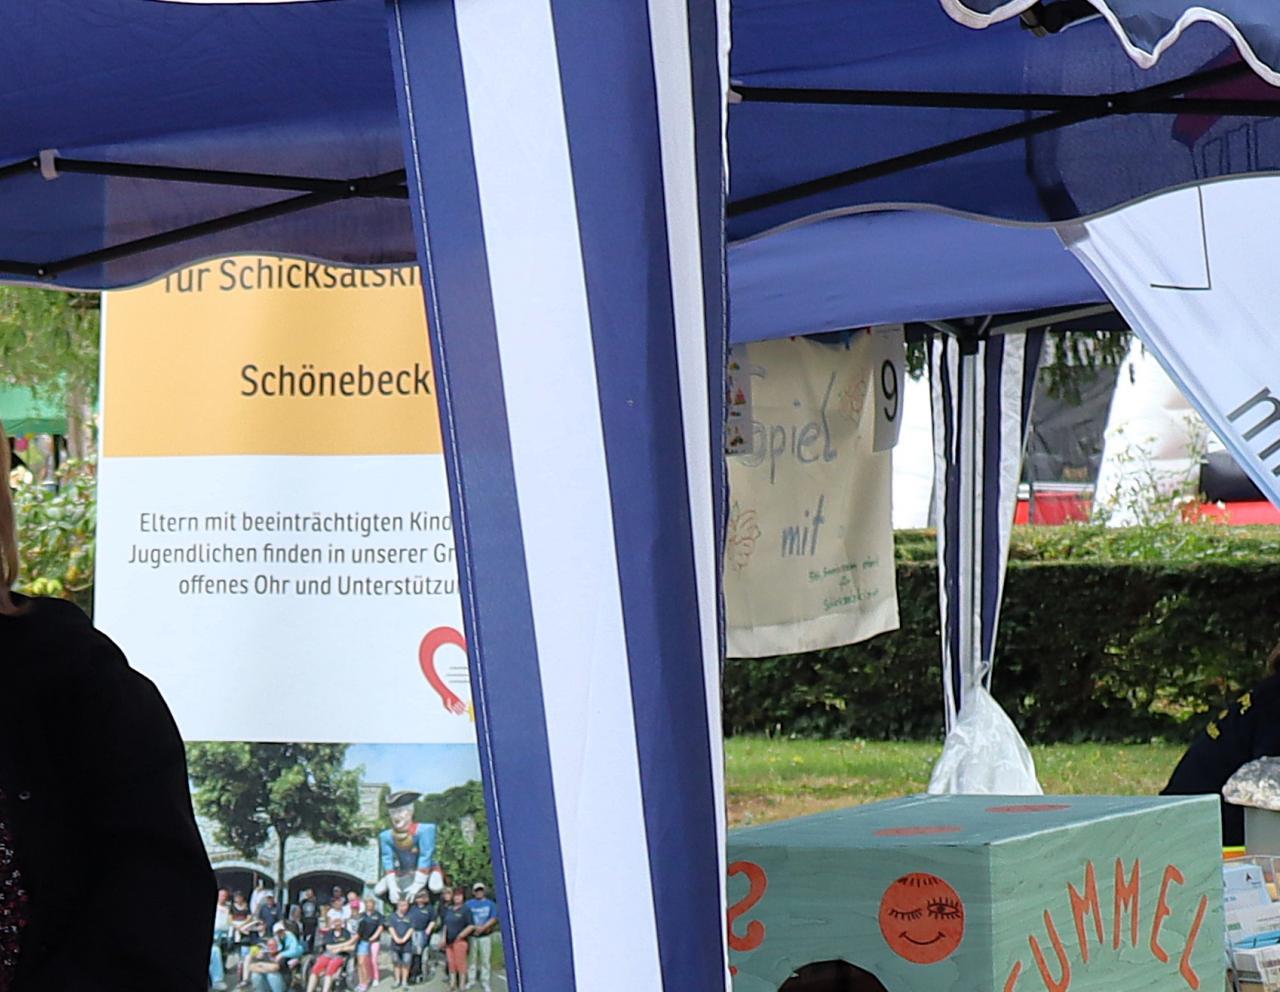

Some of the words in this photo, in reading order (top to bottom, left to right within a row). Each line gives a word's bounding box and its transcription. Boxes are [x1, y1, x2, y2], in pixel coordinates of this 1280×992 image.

[240, 362, 432, 397] Schönebeck
[880, 359, 899, 423] 9
[139, 511, 199, 533] Eltern
[204, 511, 237, 532] mit
[242, 510, 404, 538] beeinträchtigten
[409, 510, 453, 532] Kind
[781, 494, 825, 558] mit
[128, 543, 258, 568] Jugendlichen
[263, 542, 322, 564] finden
[328, 542, 345, 564] in
[351, 545, 428, 564] unserer
[433, 542, 456, 564] Gr
[178, 574, 249, 595] offenes
[254, 574, 291, 595] Ohr
[295, 575, 332, 596] und
[337, 574, 458, 596] Unterstützu
